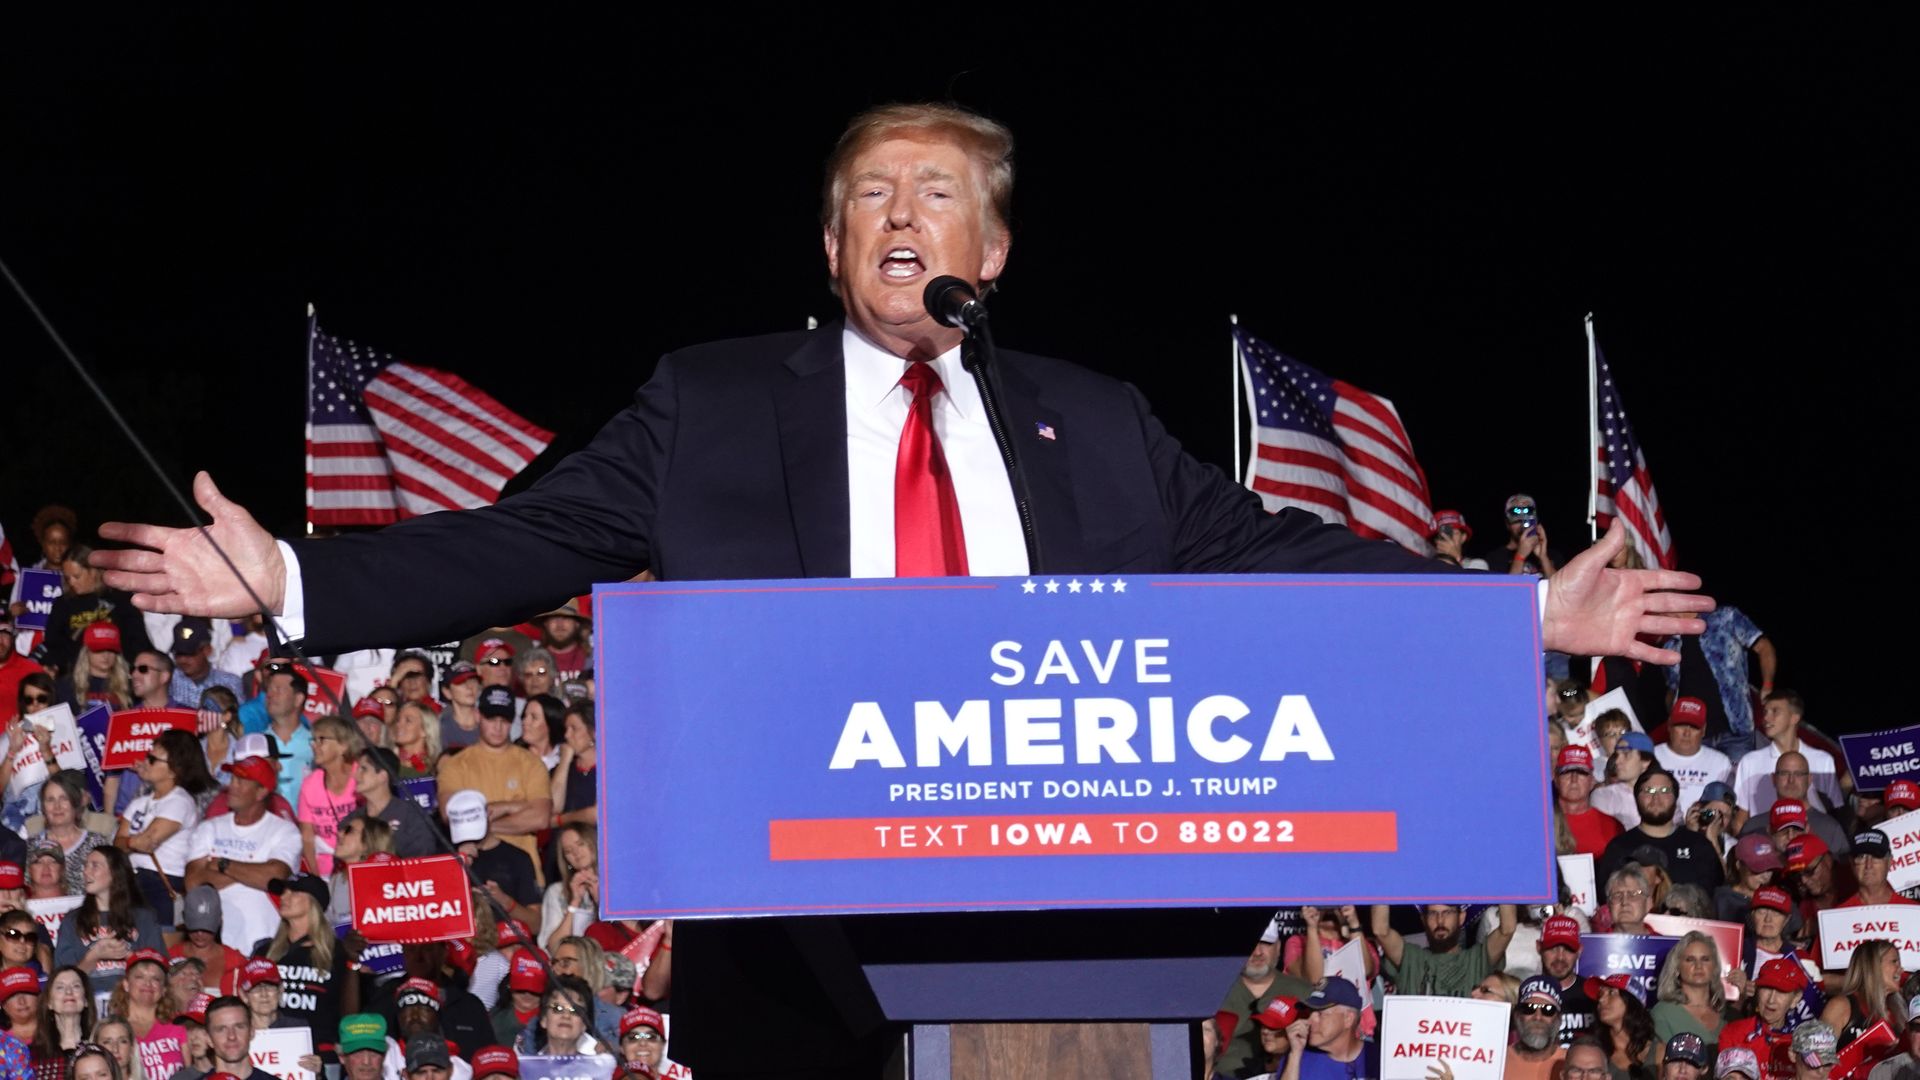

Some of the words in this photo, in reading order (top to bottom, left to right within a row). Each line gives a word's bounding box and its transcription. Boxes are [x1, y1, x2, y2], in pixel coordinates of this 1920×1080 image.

[990, 638, 1172, 686] SAVE
[828, 694, 1335, 770] AMERICA
[110, 738, 155, 754] AMER
[1870, 741, 1916, 760] SAVE
[889, 780, 1033, 802] PRESIDENT
[1043, 778, 1154, 800] DONALD
[1161, 778, 1182, 797] J.
[1190, 777, 1279, 796] TRUMP
[1775, 805, 1802, 815] TRUMP
[875, 825, 969, 848] TEXT
[990, 822, 1093, 846] IOWA
[1113, 821, 1159, 844] TO
[1179, 820, 1295, 844] 88022
[382, 879, 435, 900] SAVE
[361, 899, 463, 925] AMERICA!
[1852, 921, 1900, 934] SAVE
[1607, 954, 1656, 970] SAVE
[277, 964, 332, 984] RUMP
[1417, 1019, 1473, 1037] SAVE
[1393, 1042, 1495, 1064] AMERICA!
